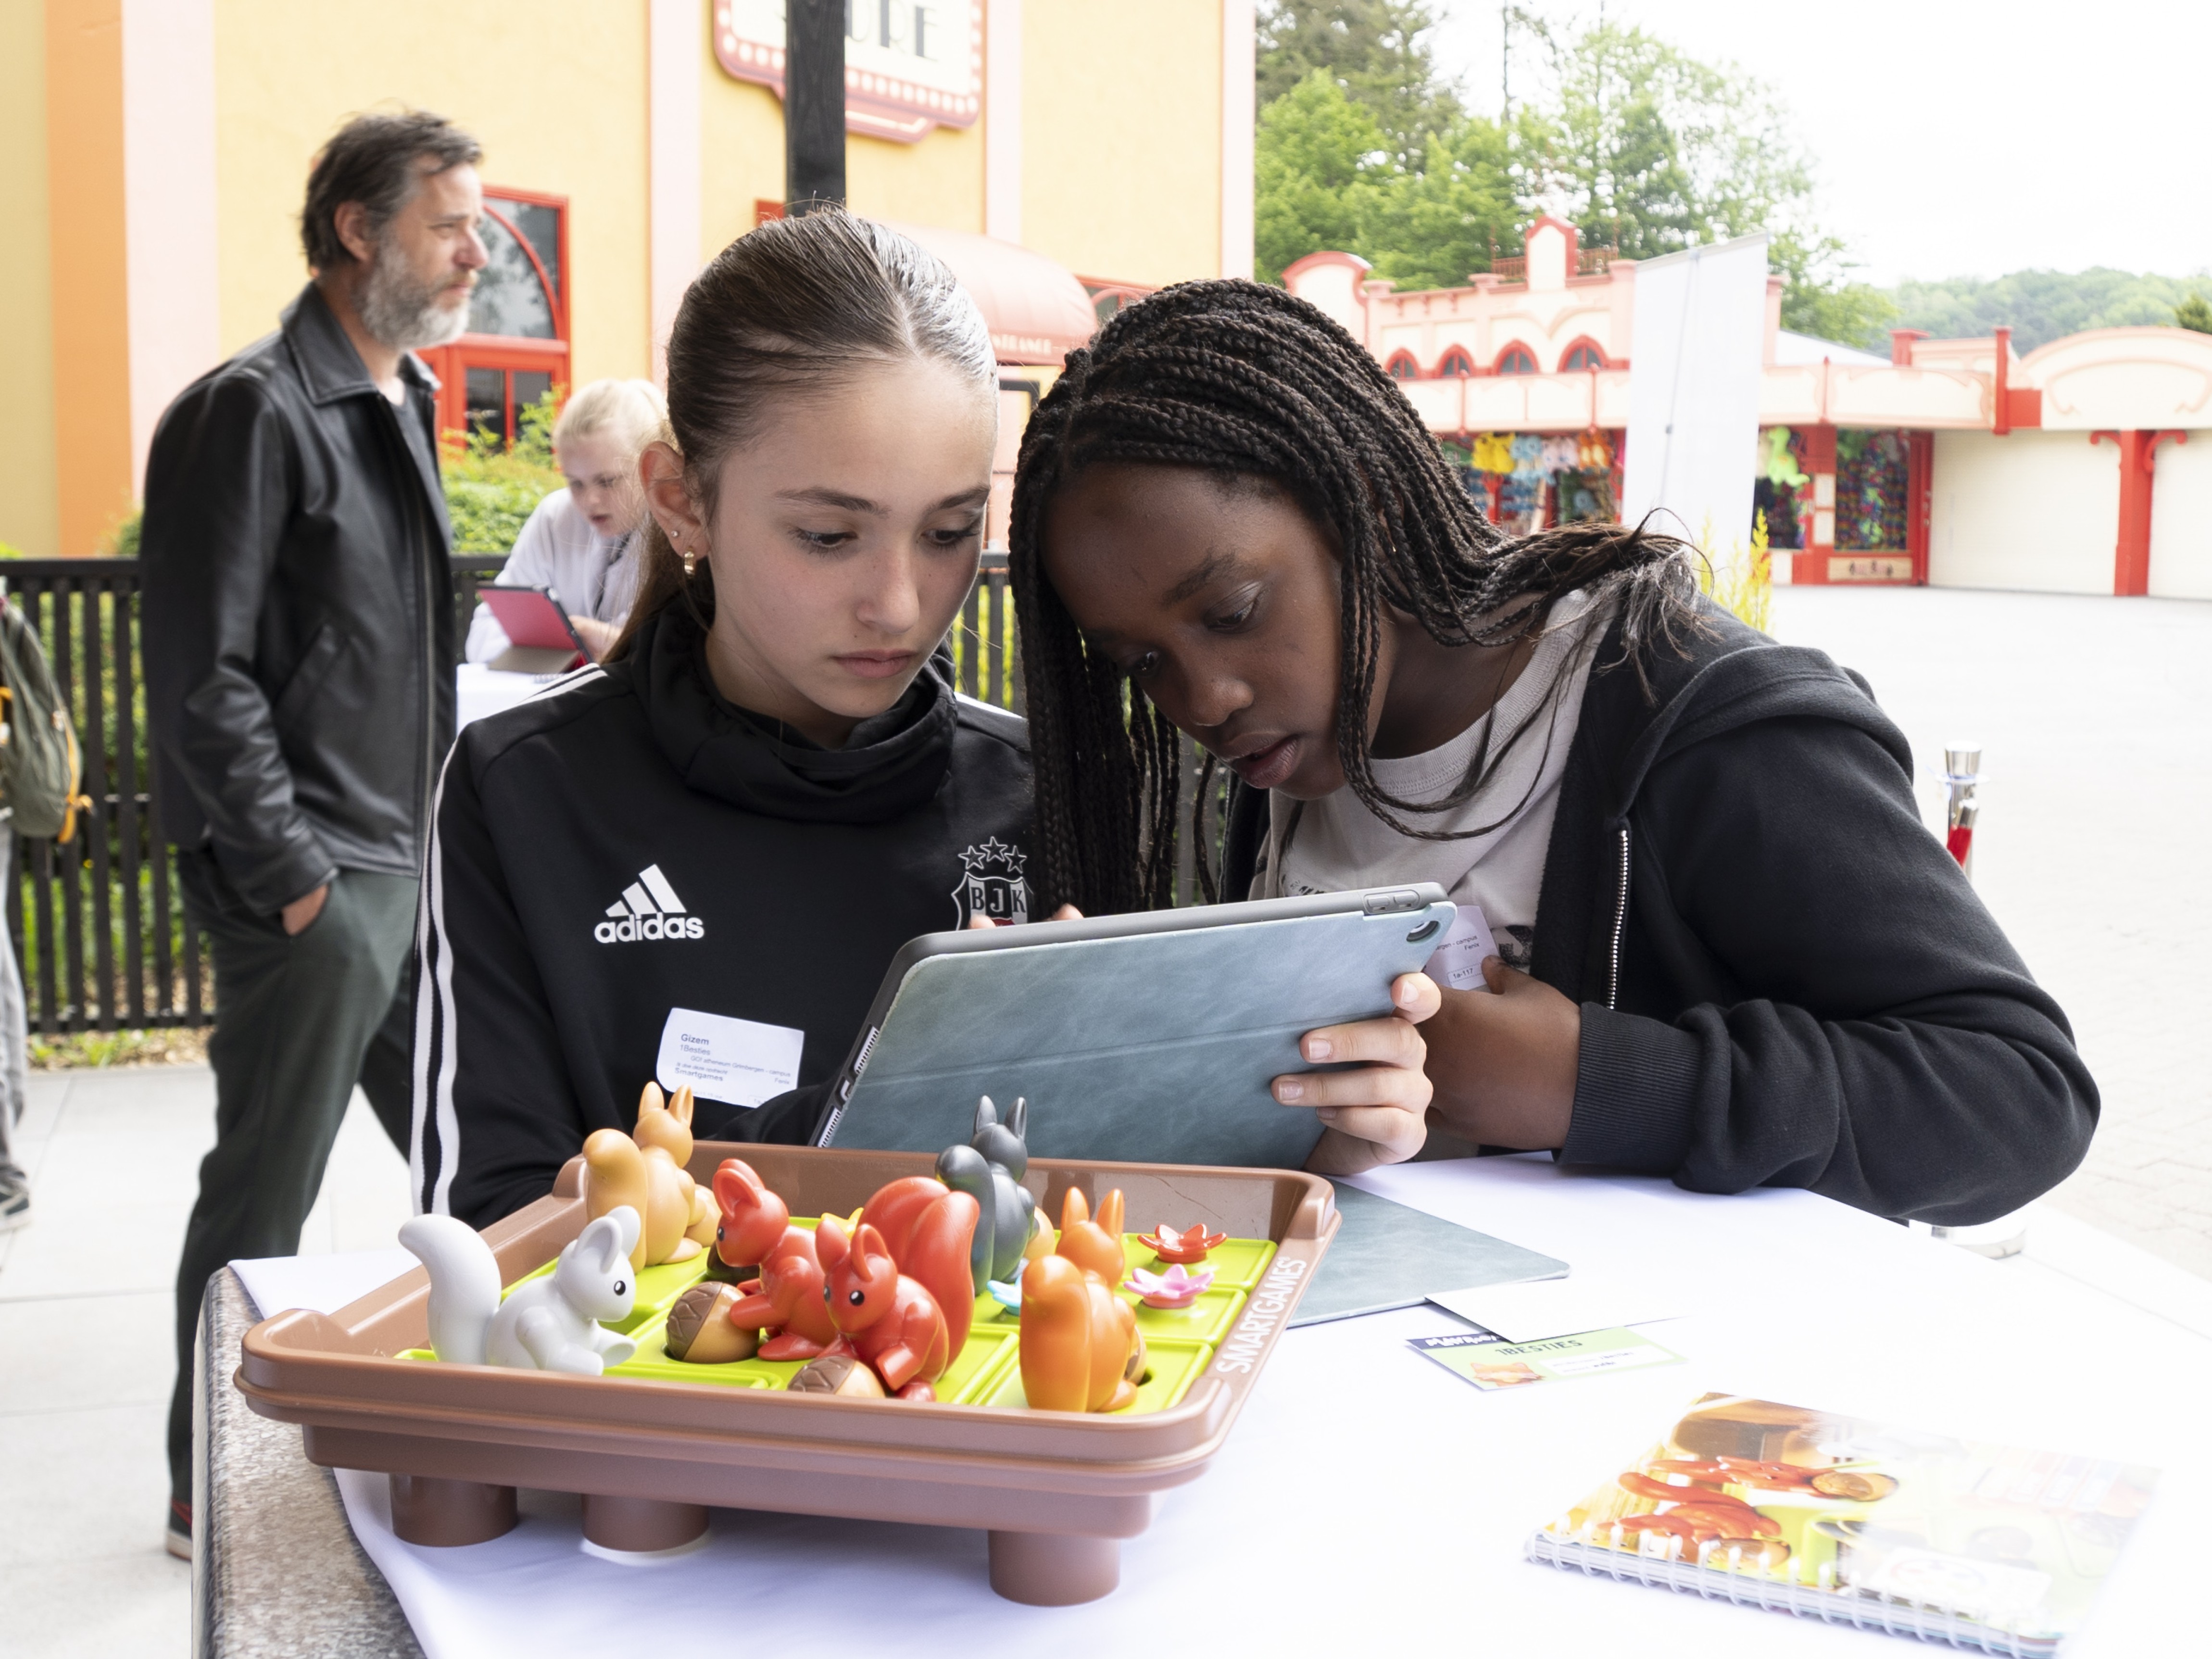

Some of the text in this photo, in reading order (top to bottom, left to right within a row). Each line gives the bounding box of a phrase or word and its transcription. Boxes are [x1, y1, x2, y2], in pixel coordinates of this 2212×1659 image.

[594, 912, 704, 943] adidas
[681, 1033, 709, 1045] Gizem
[679, 1044, 711, 1056] 1Besties
[675, 1068, 723, 1082] Smartgames
[1215, 1258, 1307, 1374] SMARTGAMES
[1495, 1339, 1583, 1356] 1BESTIES
